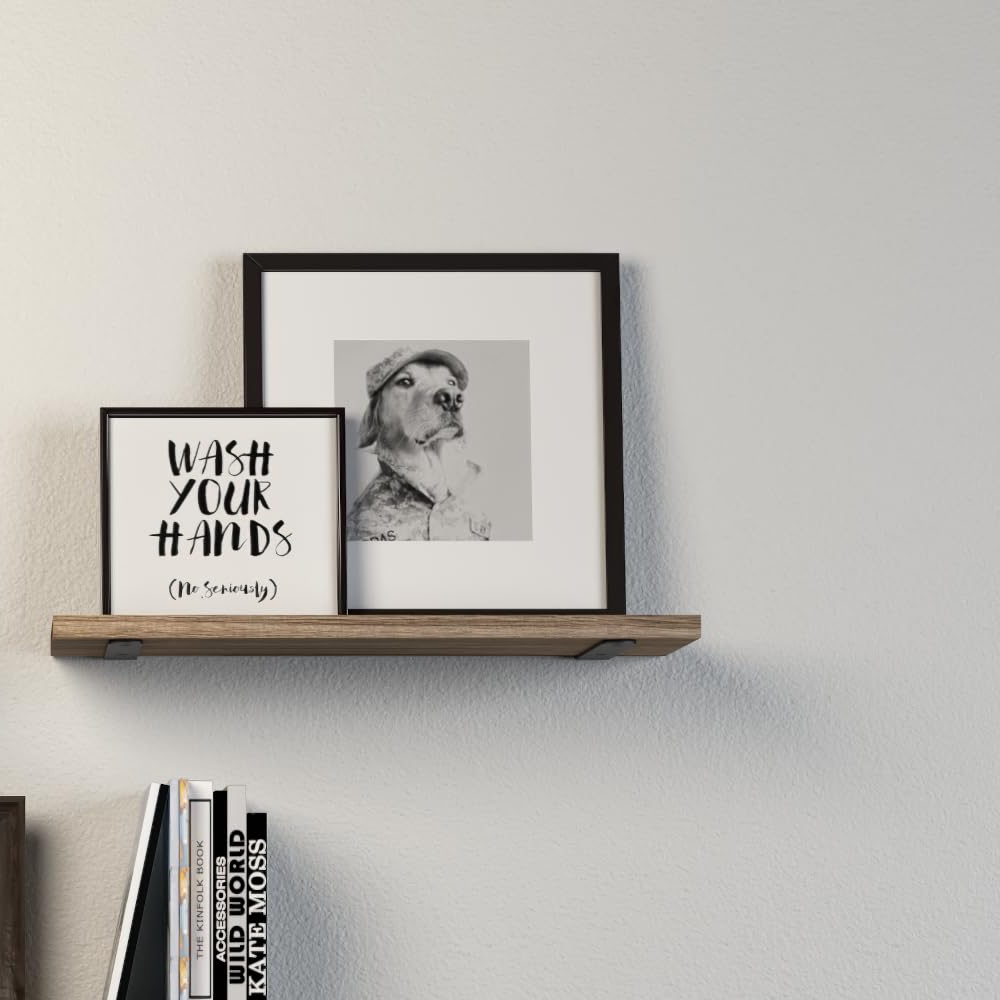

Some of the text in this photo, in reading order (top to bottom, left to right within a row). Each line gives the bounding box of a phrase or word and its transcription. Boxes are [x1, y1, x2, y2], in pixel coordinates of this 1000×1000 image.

[168, 439, 274, 477] WASH
[169, 478, 271, 516] YOUR
[149, 519, 293, 557] HANDS
[168, 578, 278, 603] (No Seriously)
[195, 840, 204, 961] THE KINFOLK BOOK
[215, 856, 227, 963] ACCESSORIES
[229, 829, 246, 985] WILD WORLD
[249, 838, 267, 996] KATE MOSS
